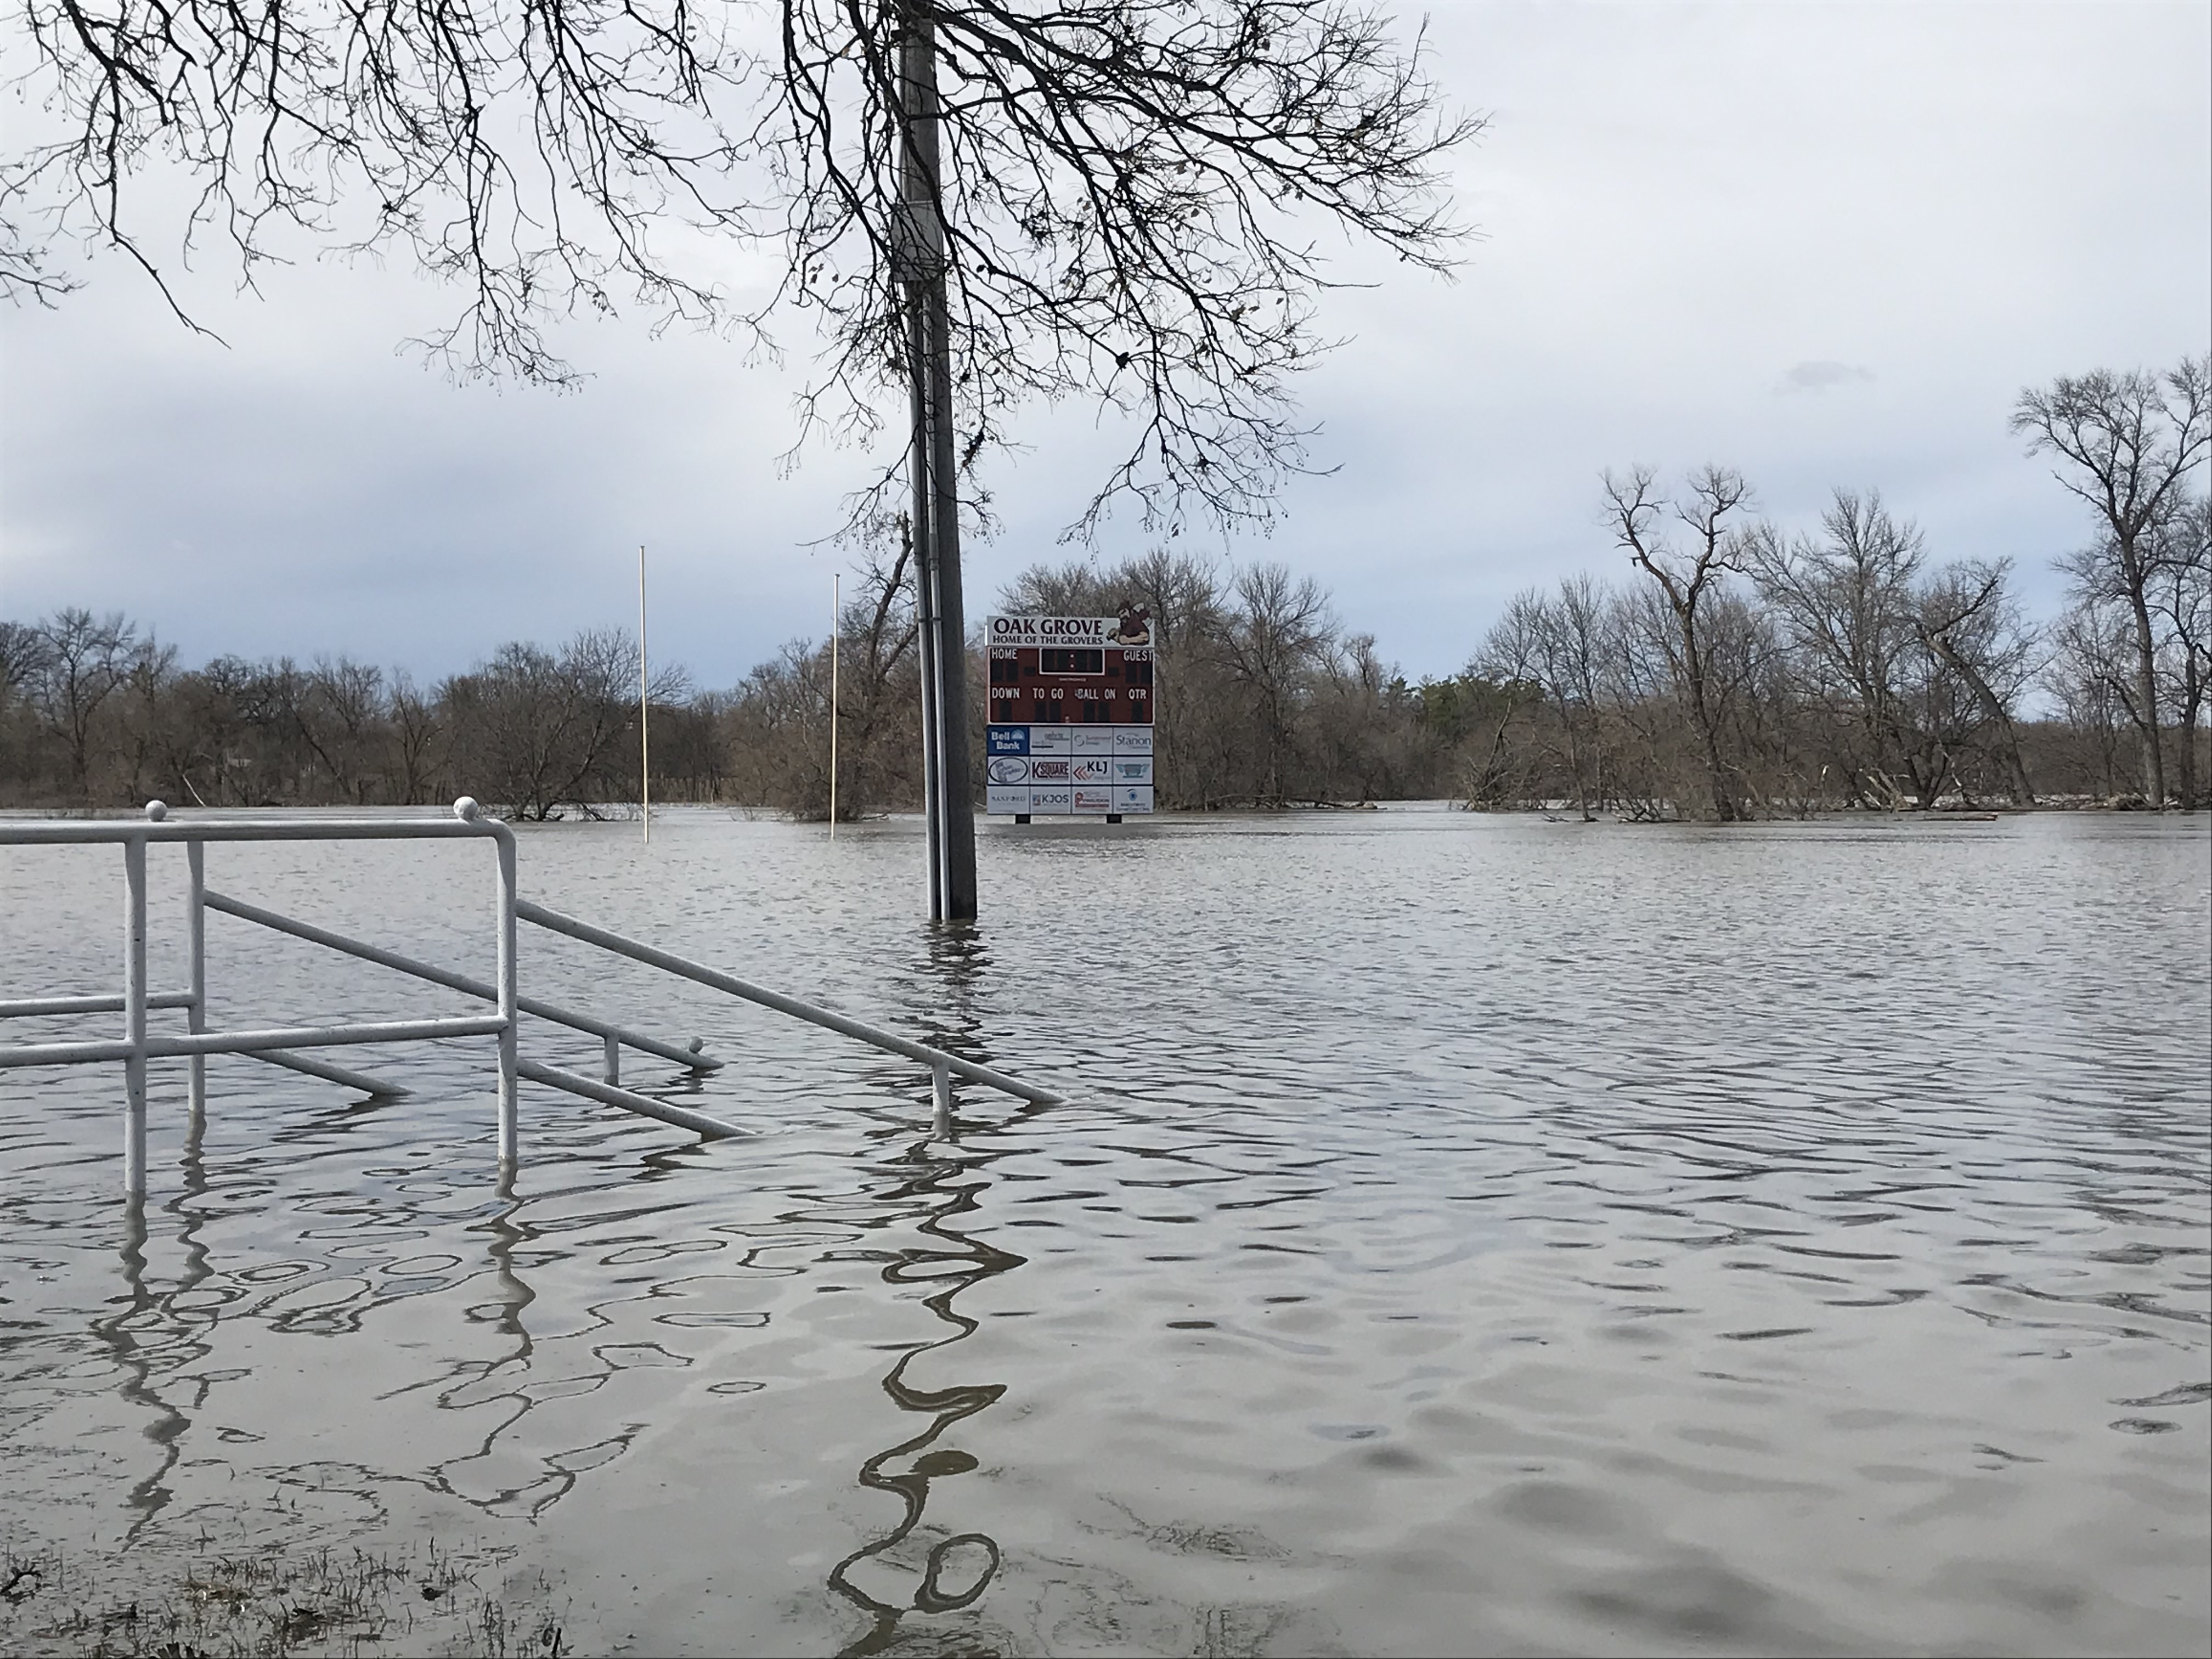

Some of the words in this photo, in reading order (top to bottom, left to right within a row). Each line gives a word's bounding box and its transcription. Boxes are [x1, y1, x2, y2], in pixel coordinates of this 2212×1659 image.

[994, 618, 1036, 634] OAK
[1041, 619, 1103, 635] GROVE
[992, 635, 1022, 644] HOME
[1025, 636, 1036, 644] OF
[1061, 636, 1103, 645] GROVERS
[992, 648, 1018, 659] HOME
[1124, 650, 1154, 661] GUEST
[992, 687, 1020, 699] DOWN
[1032, 688, 1045, 699] TO
[1051, 688, 1063, 699] GO
[1104, 689, 1116, 699] ON
[1128, 689, 1147, 699] QTR
[991, 732, 1009, 740] Bell
[996, 741, 1020, 749] Bank
[1087, 761, 1107, 774] KLJ
[1042, 794, 1069, 803] KJOS
